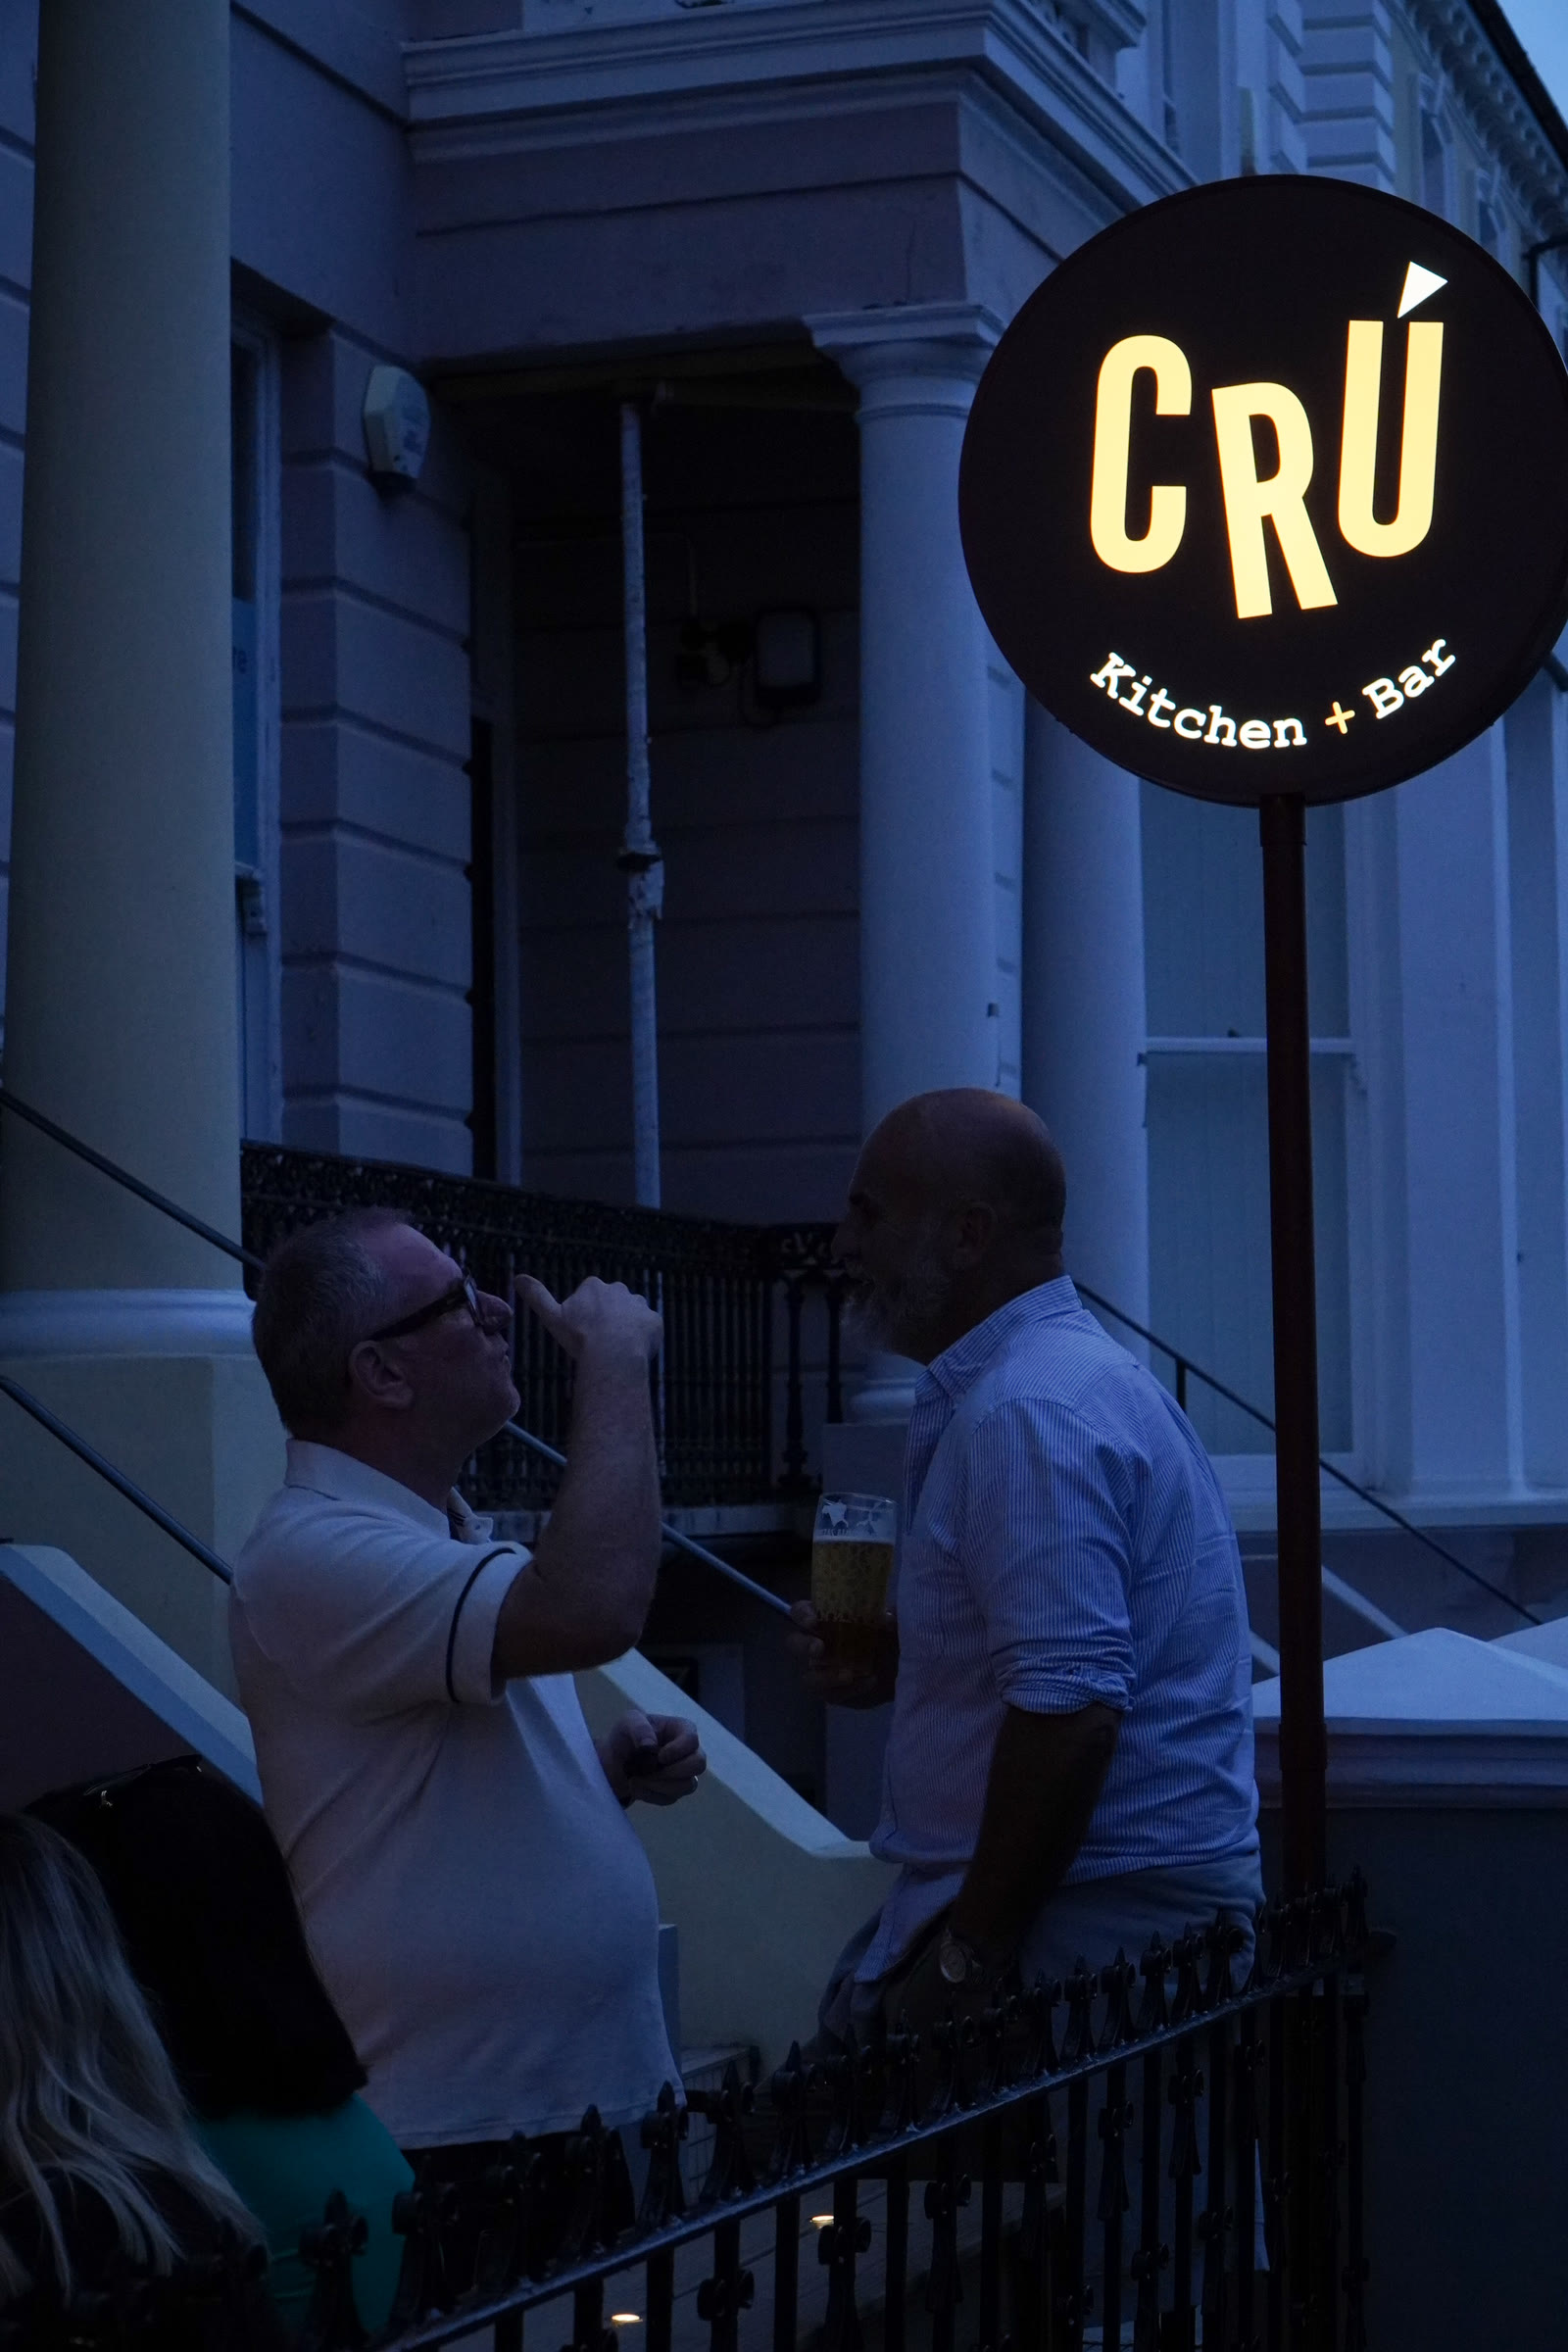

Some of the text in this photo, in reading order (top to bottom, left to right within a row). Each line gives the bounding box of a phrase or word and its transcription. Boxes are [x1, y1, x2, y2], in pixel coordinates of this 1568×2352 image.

[1090, 262, 1447, 618] CRÚ
[1090, 639, 1456, 749] Kitchen + Bar
